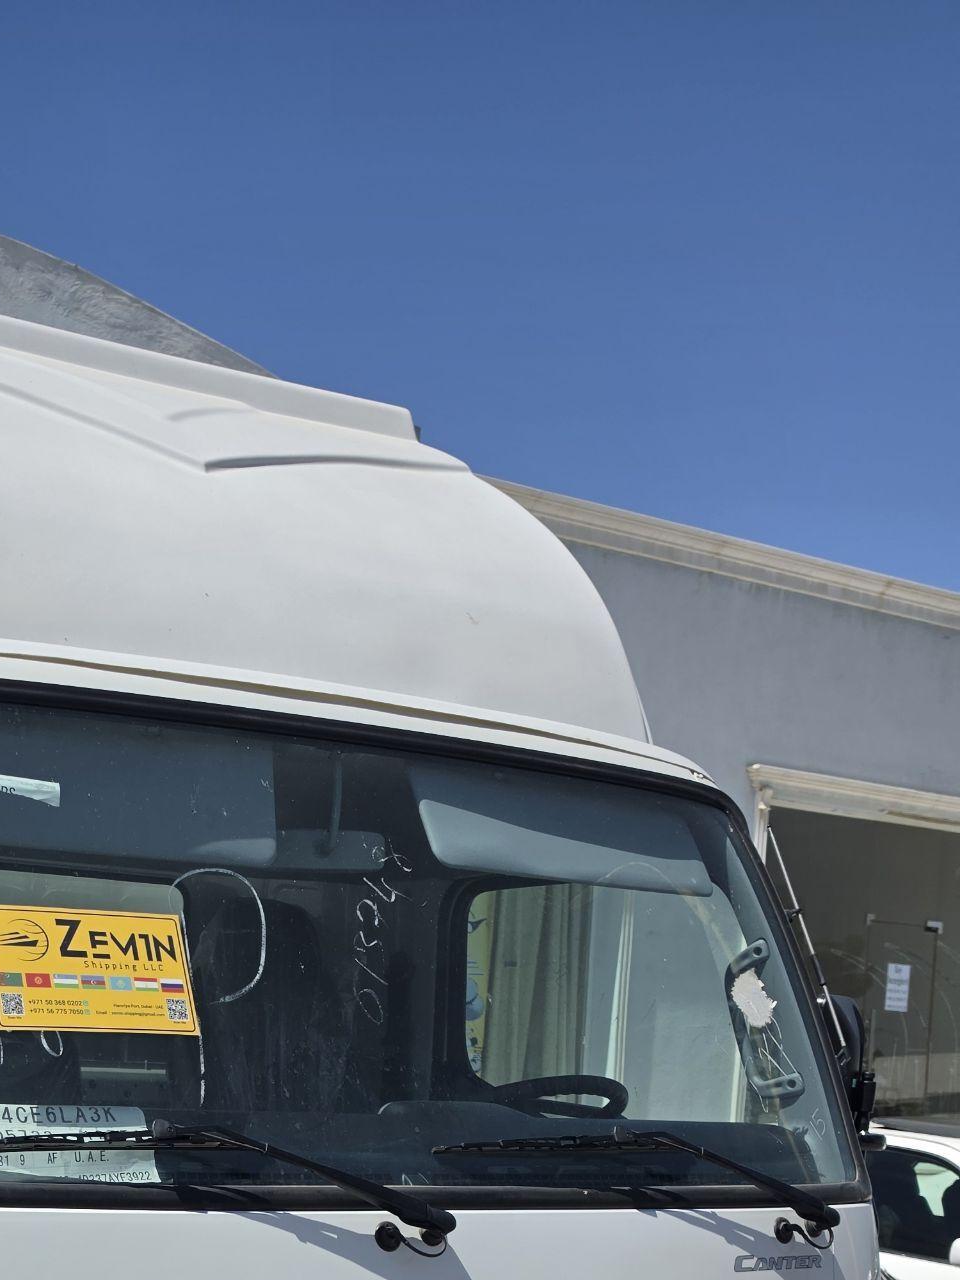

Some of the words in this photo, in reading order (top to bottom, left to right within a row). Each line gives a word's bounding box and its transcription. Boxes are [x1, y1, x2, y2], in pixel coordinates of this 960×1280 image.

[54, 918, 178, 962] ZEMIN
[83, 960, 138, 972] Shipping
[143, 963, 164, 972] LLC
[47, 1152, 58, 1164] AF
[734, 1254, 823, 1272] CANTER
